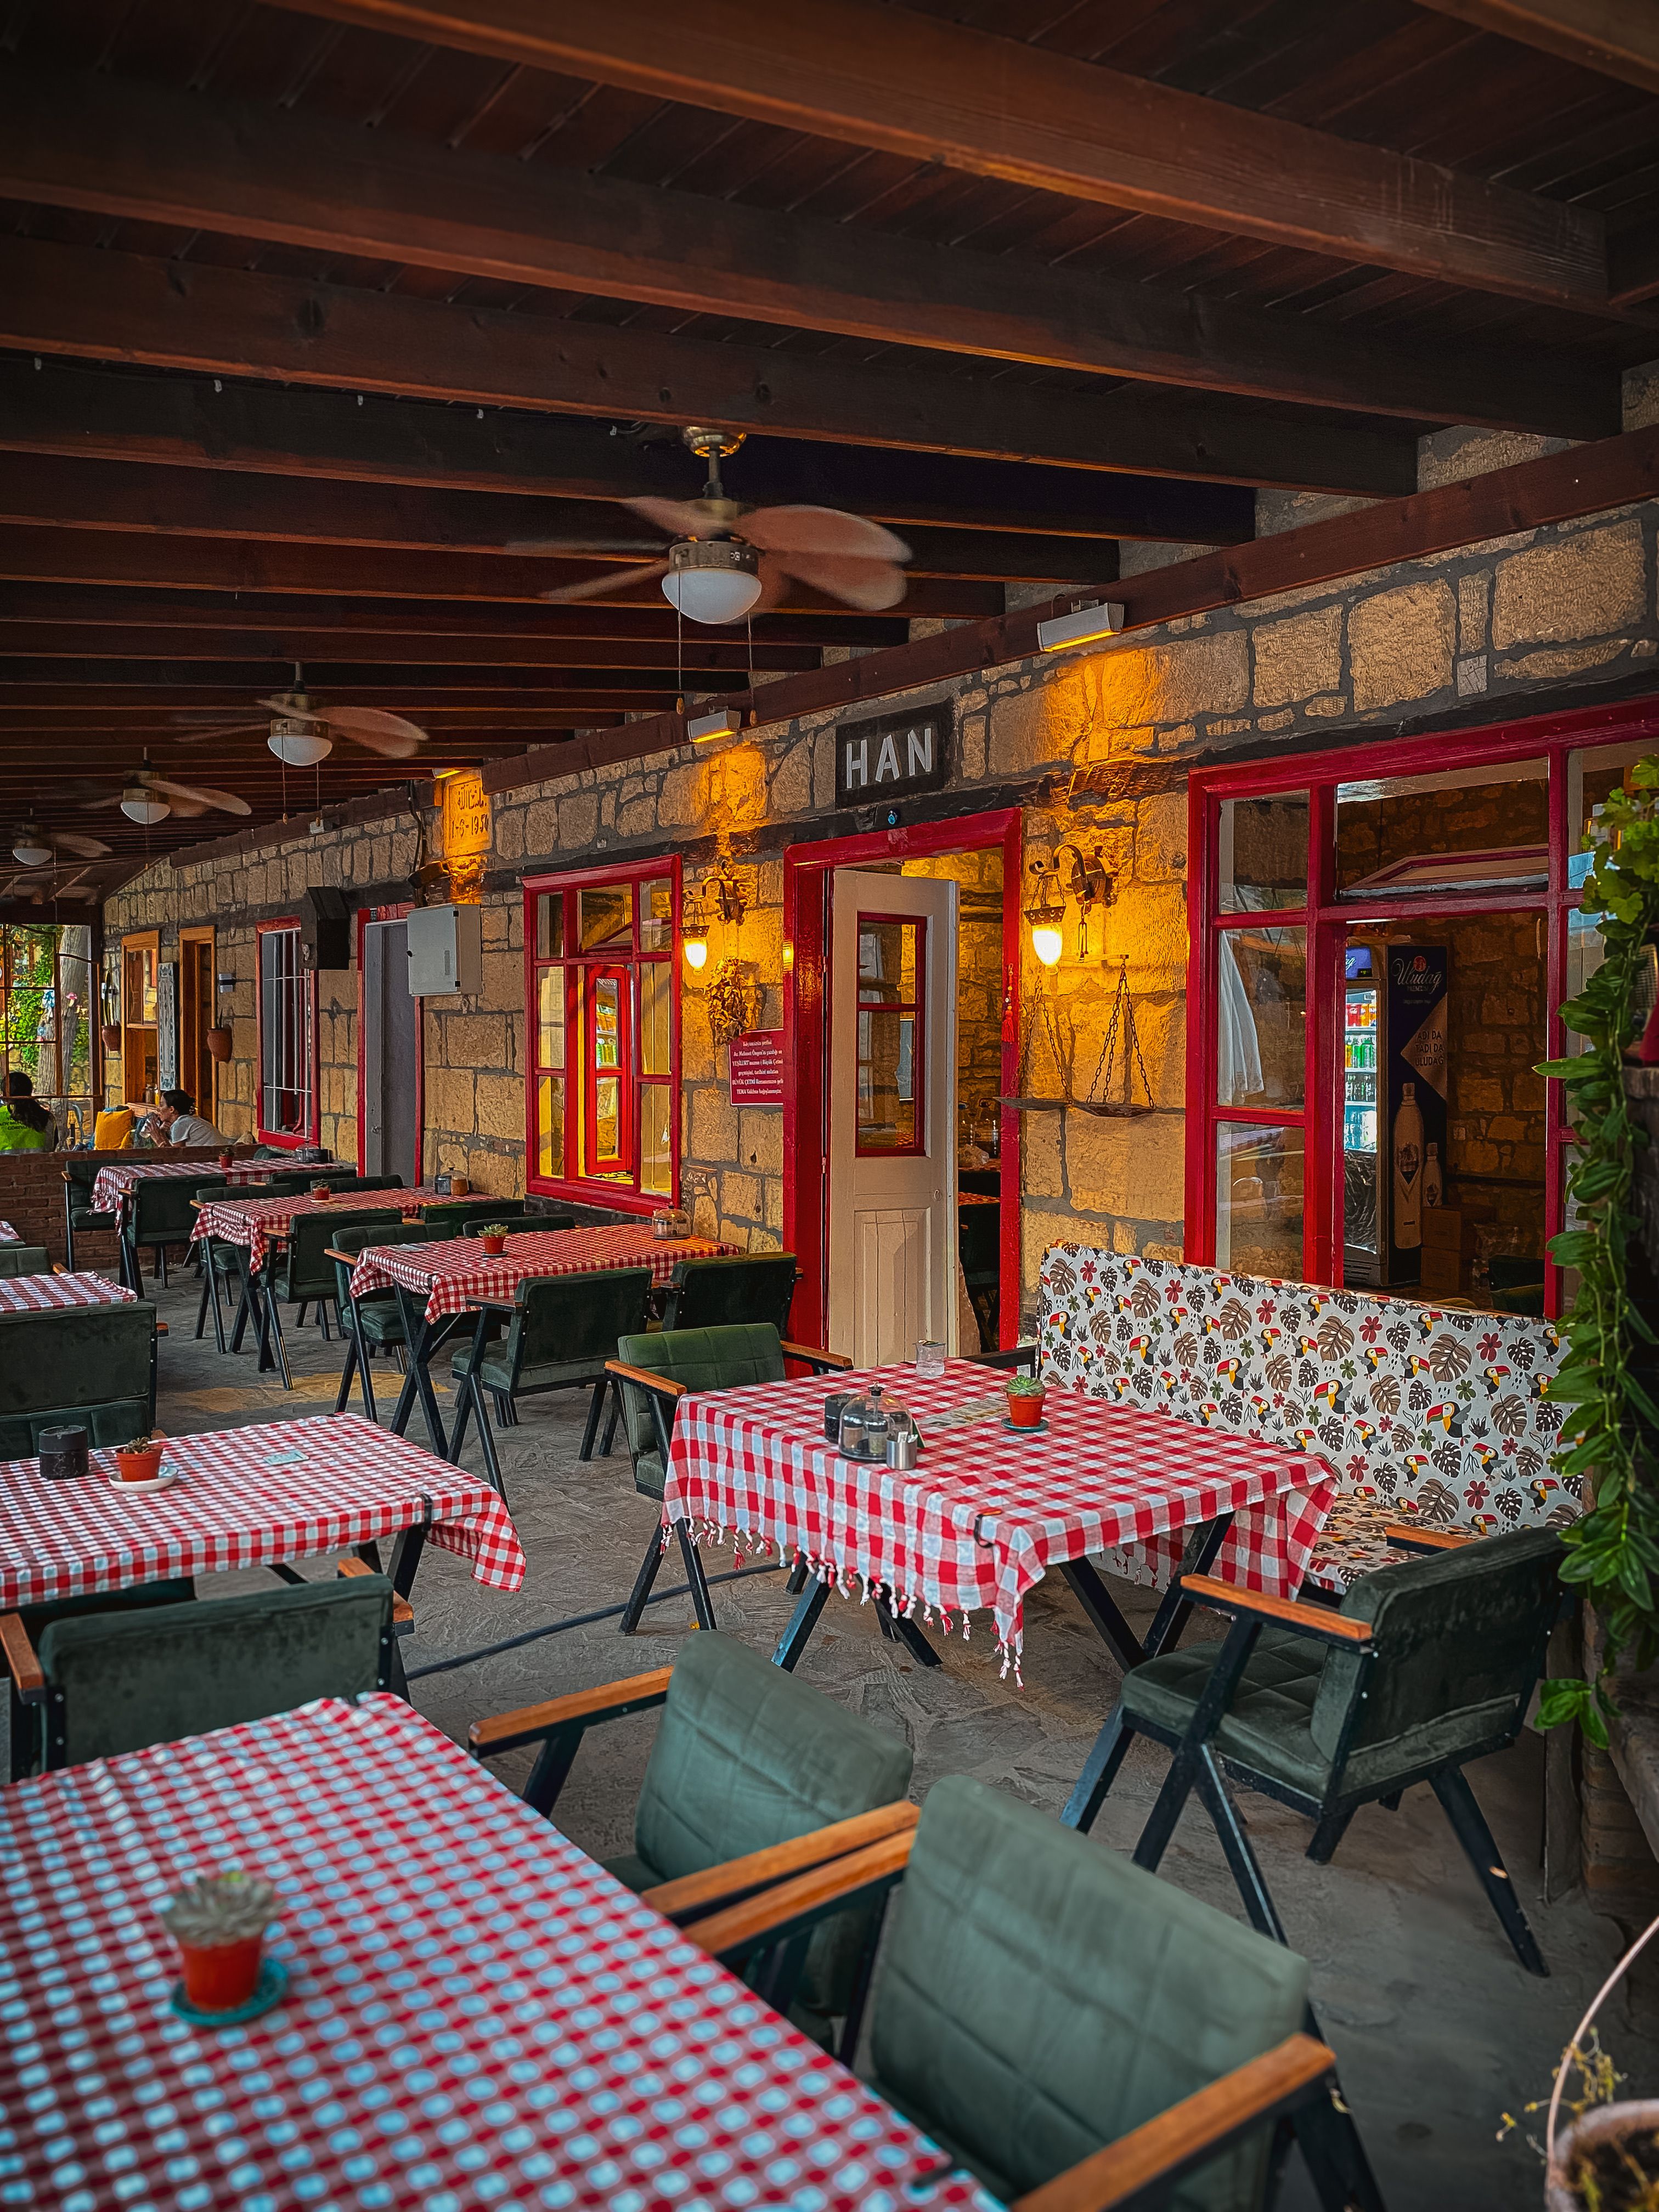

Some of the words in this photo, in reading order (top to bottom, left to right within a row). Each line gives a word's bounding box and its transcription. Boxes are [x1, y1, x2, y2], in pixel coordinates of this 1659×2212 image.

[847, 728, 932, 788] HAN
[1391, 958, 1442, 994] Uludağ
[1417, 1031, 1429, 1040] ADI
[1431, 1030, 1442, 1040] DA
[1415, 1043, 1432, 1053] TADI
[1434, 1043, 1443, 1052] DA
[1415, 1056, 1443, 1066] ULUDAĞ
